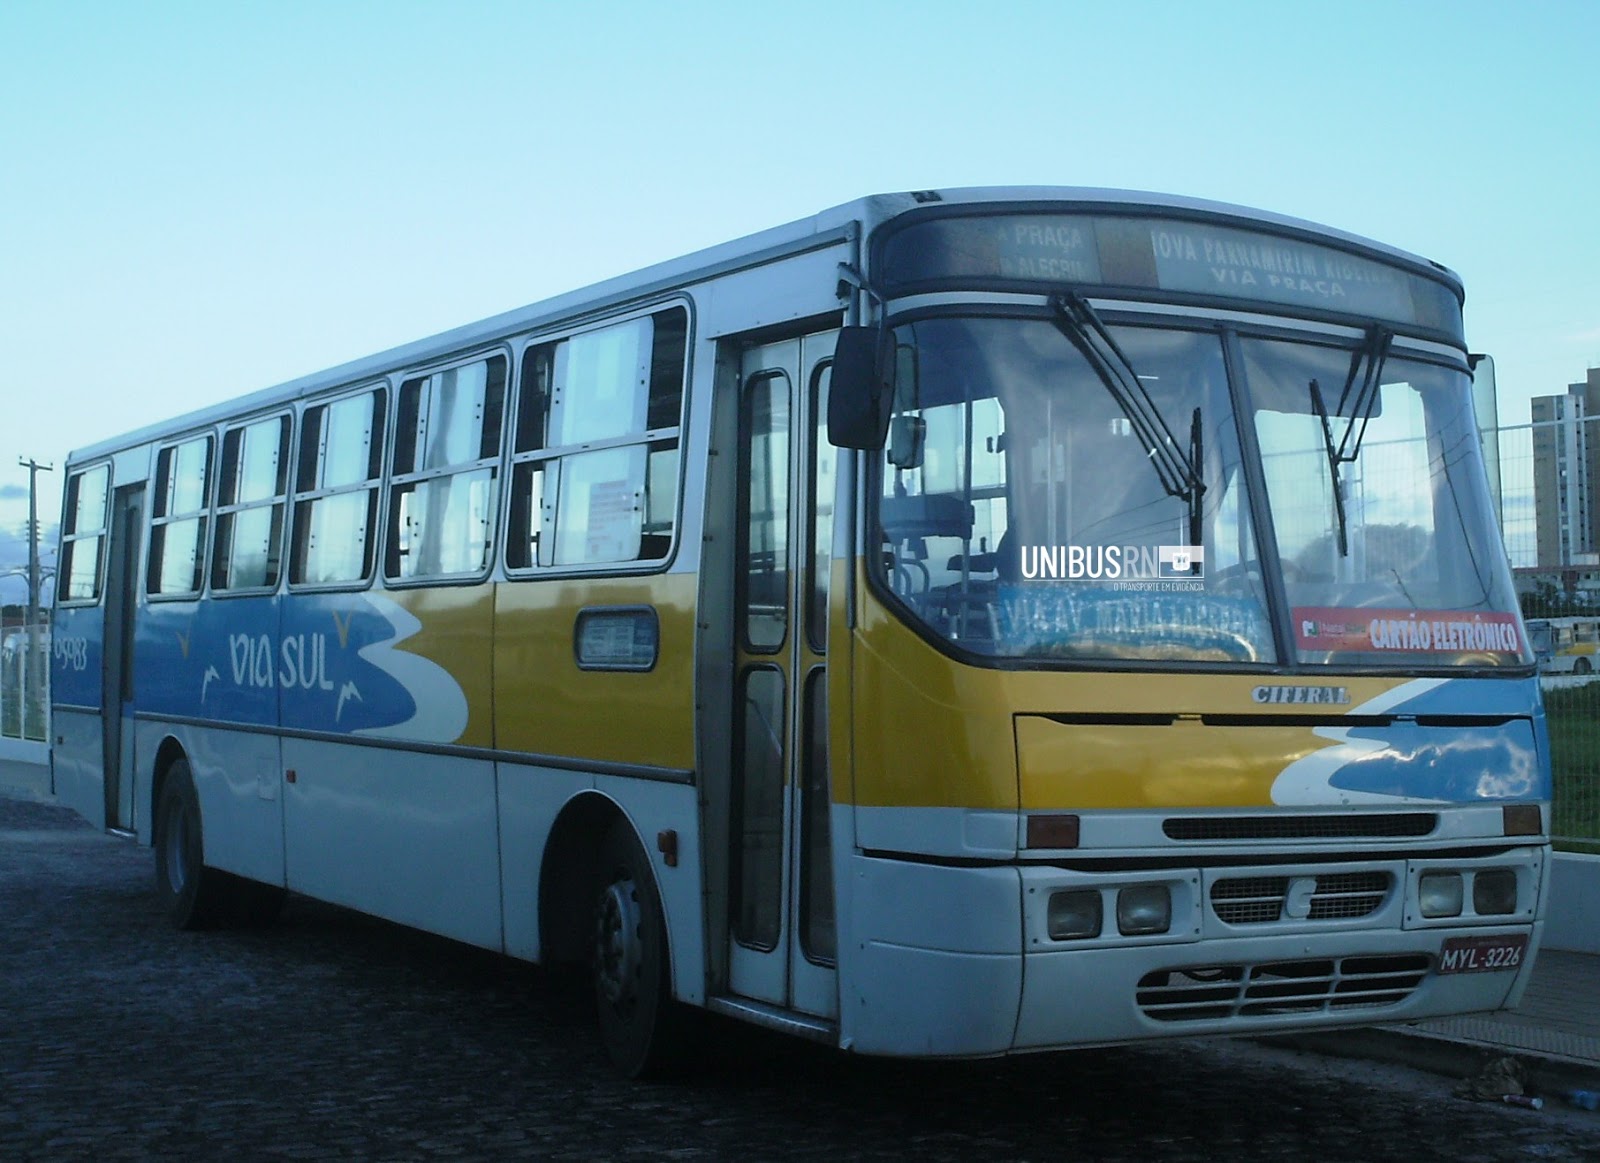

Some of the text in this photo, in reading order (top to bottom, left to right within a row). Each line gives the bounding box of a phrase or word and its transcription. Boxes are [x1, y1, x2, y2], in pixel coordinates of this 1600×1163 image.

[1014, 223, 1083, 253] PRAÇA
[1202, 238, 1317, 277] PARNAMIRIM
[1210, 266, 1346, 298] VIA PRAÇA
[1369, 613, 1518, 652] CARTÃO ELETRÔNICO
[229, 632, 334, 691] VIA SUL
[1251, 685, 1351, 704] CIFERAL
[1441, 946, 1522, 970] MYL-3226
